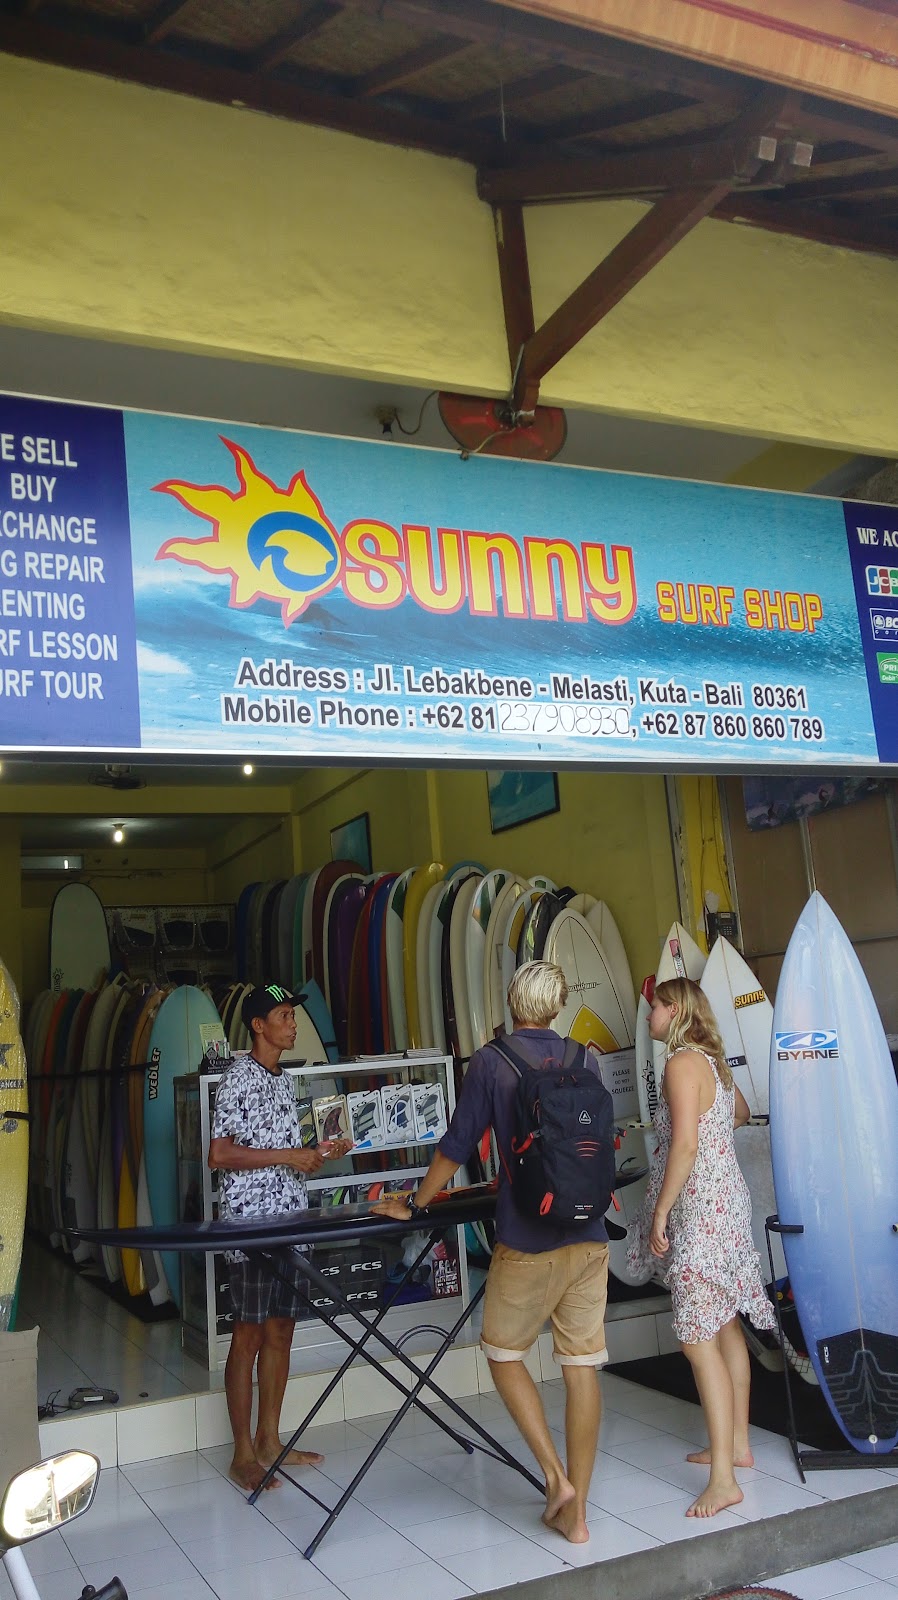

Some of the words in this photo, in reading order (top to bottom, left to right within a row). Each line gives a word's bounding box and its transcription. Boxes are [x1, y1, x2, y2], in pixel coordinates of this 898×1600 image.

[22, 435, 78, 468] SELL
[11, 472, 57, 503] BUY
[0, 510, 97, 545] CHANGE
[857, 527, 879, 546] WE
[24, 551, 106, 584] REPAIR
[870, 576, 898, 587] JCB
[0, 588, 86, 620] ENTING
[656, 581, 735, 627] SURF
[743, 588, 823, 633] SHOP
[28, 630, 118, 661] LESSON
[0, 669, 34, 698] RF
[40, 670, 104, 700] TOUR
[237, 660, 347, 690] Address
[370, 666, 400, 692] Jl.
[406, 668, 532, 698] Lebakbene
[553, 676, 634, 704] Melasti,
[640, 680, 687, 704] Kuta
[706, 684, 743, 706] Bali
[753, 685, 808, 709] 80361
[223, 696, 312, 723] Mobile
[320, 700, 399, 726] Phone
[422, 706, 465, 729] +62
[643, 713, 678, 736] +62
[685, 714, 706, 737] 87
[713, 716, 747, 738] 860
[753, 717, 786, 739] 860
[790, 718, 823, 740] 789
[735, 990, 766, 1007] sunny
[777, 1049, 840, 1061] BYRNE
[612, 1069, 630, 1077] PLEASE
[611, 1086, 634, 1095] SQUEEZE
[320, 1266, 340, 1277] CS
[351, 1260, 382, 1273] FCS
[311, 1297, 334, 1308] CS
[346, 1290, 378, 1302] FCS
[216, 1312, 234, 1323] FC
